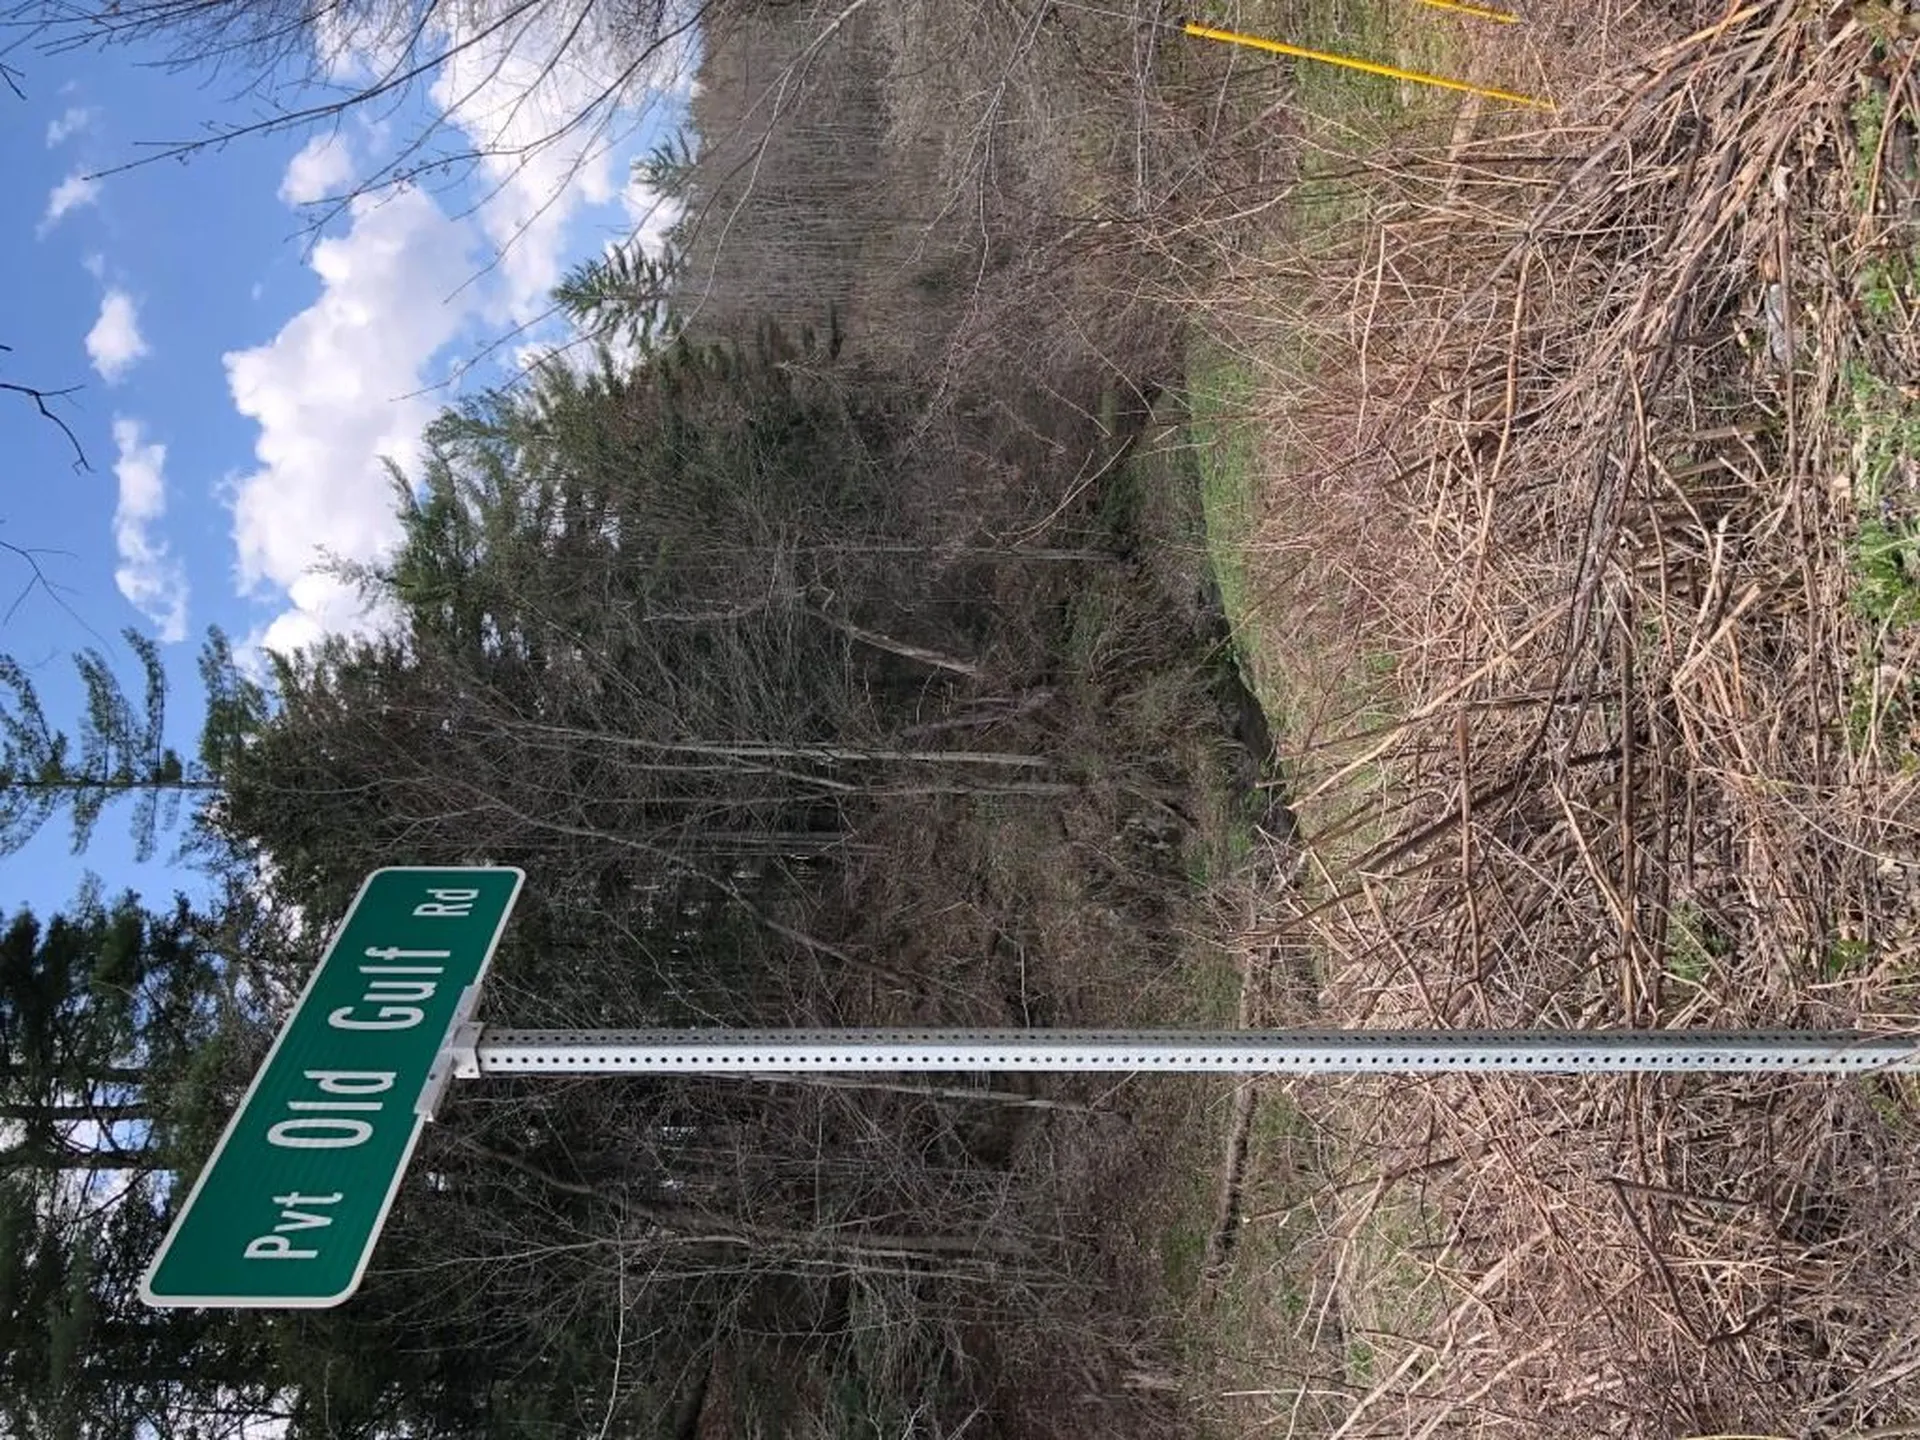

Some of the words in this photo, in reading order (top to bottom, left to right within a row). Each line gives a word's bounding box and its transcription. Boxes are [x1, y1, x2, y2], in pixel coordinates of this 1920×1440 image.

[413, 888, 480, 916] Rd
[328, 946, 451, 1030] Gulf
[267, 1070, 397, 1148] Old
[243, 1192, 343, 1259] Pvt
